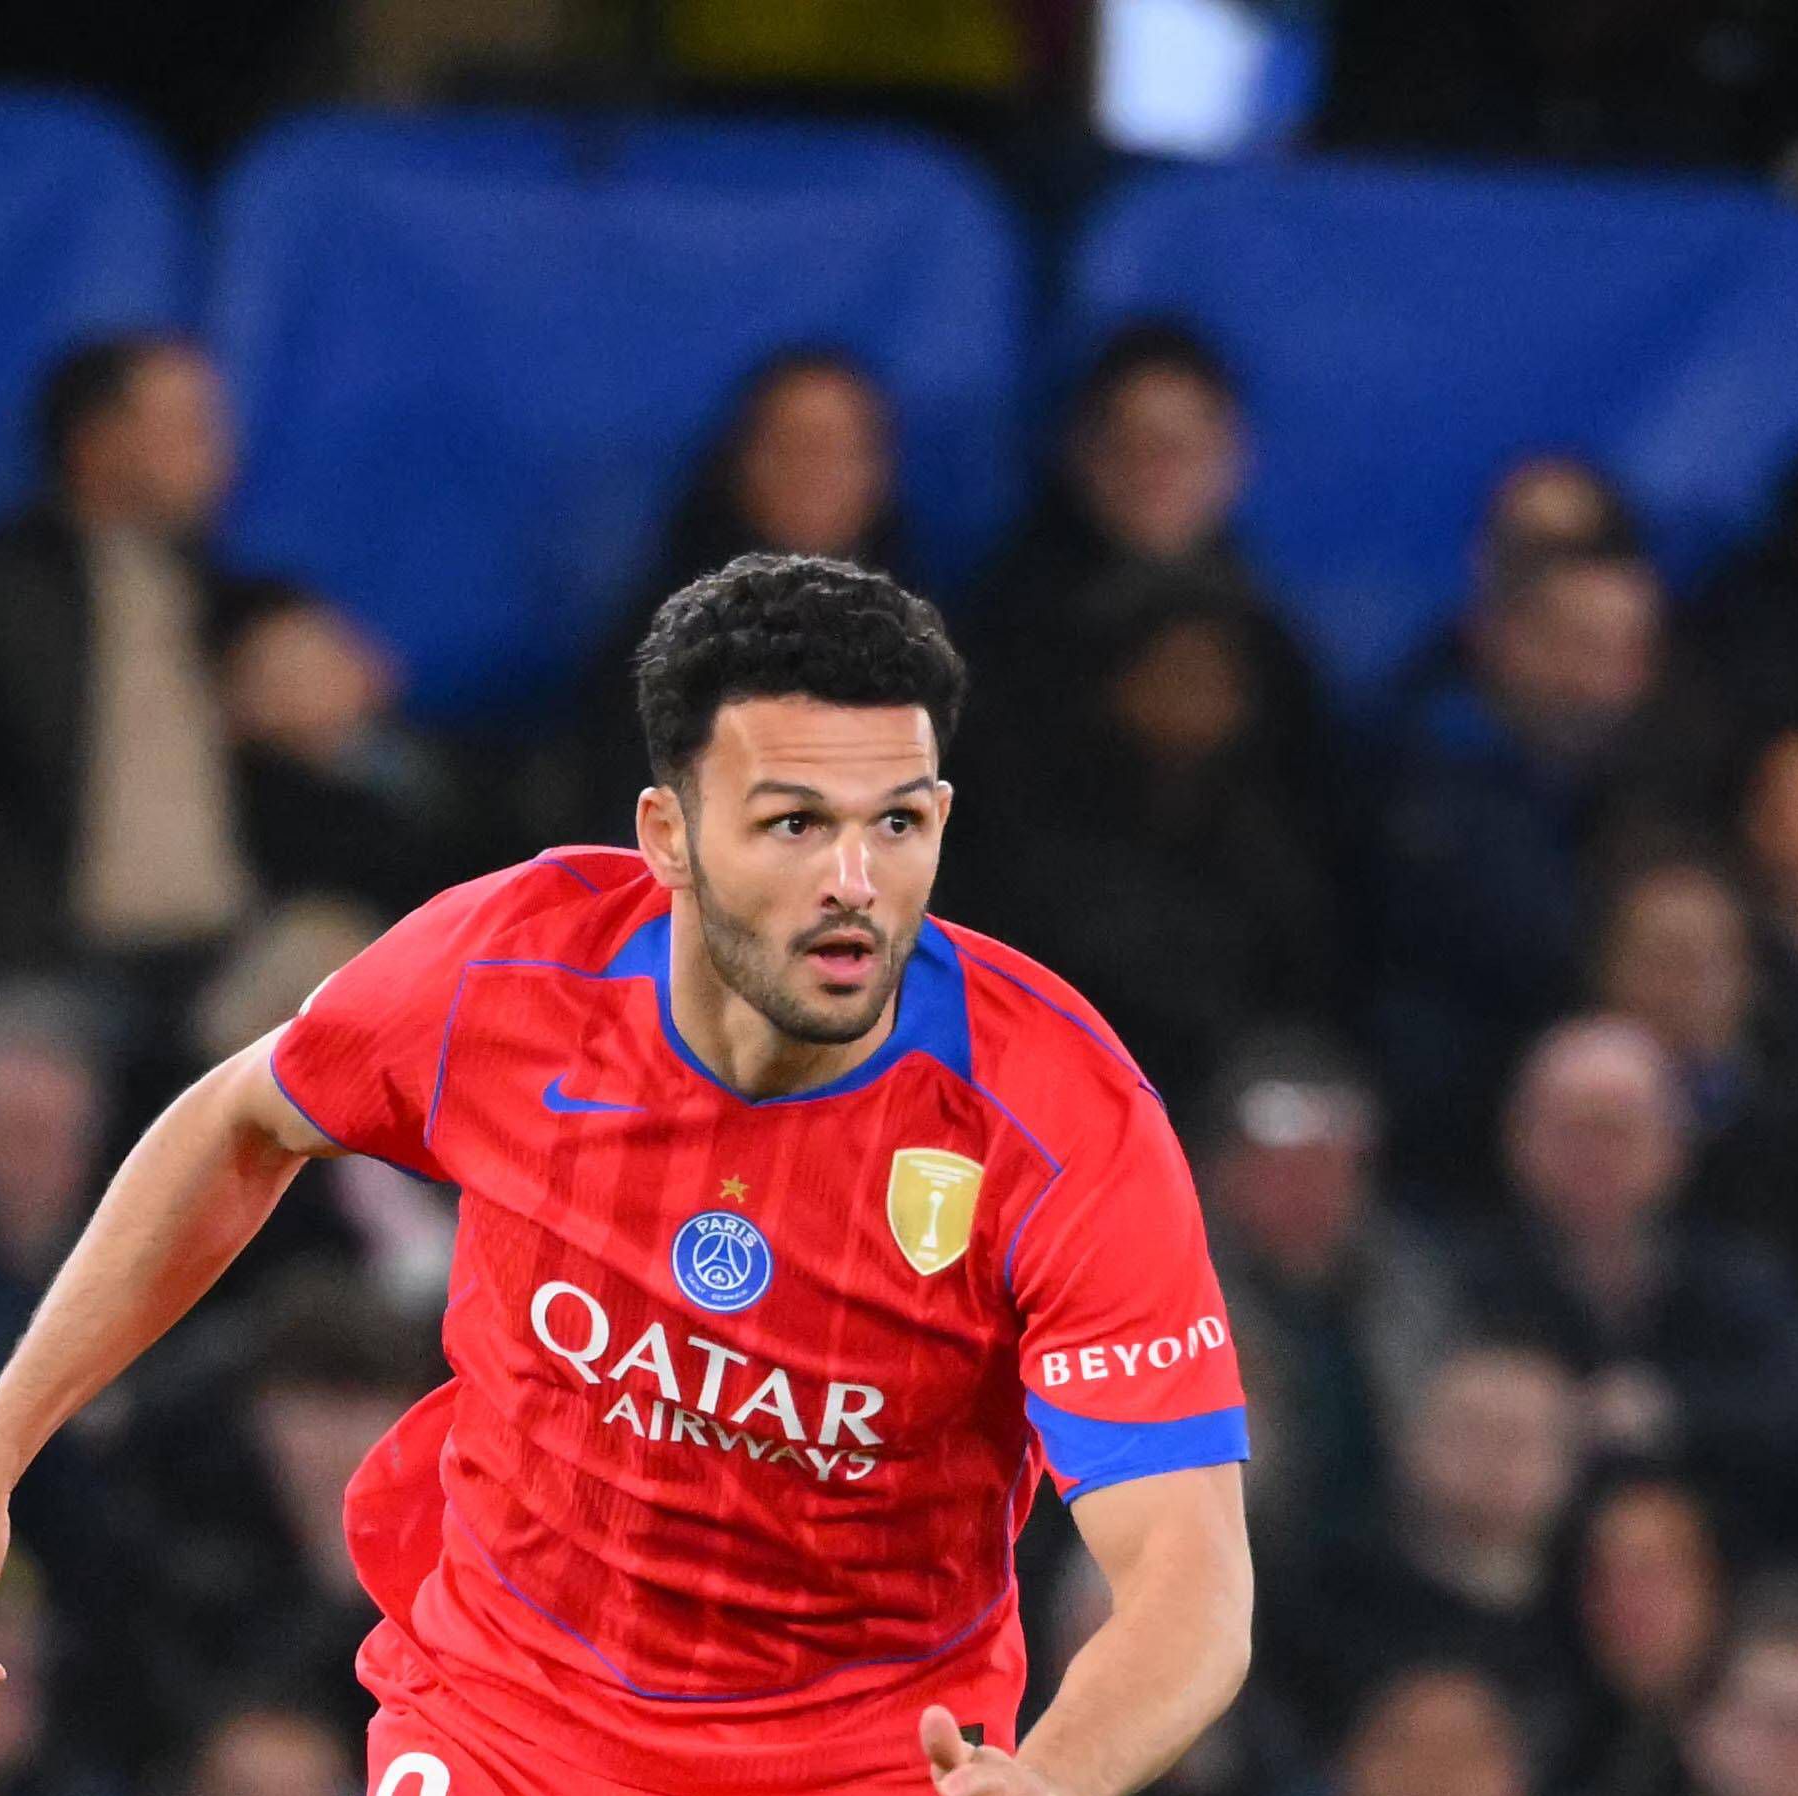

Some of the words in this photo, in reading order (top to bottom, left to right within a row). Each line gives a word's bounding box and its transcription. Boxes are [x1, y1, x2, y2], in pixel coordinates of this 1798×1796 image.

[695, 1217, 757, 1248] PARIS
[530, 1280, 884, 1446] QATAR
[1042, 1315, 1226, 1387] BEYOND
[602, 1392, 877, 1481] AIRWAYS
